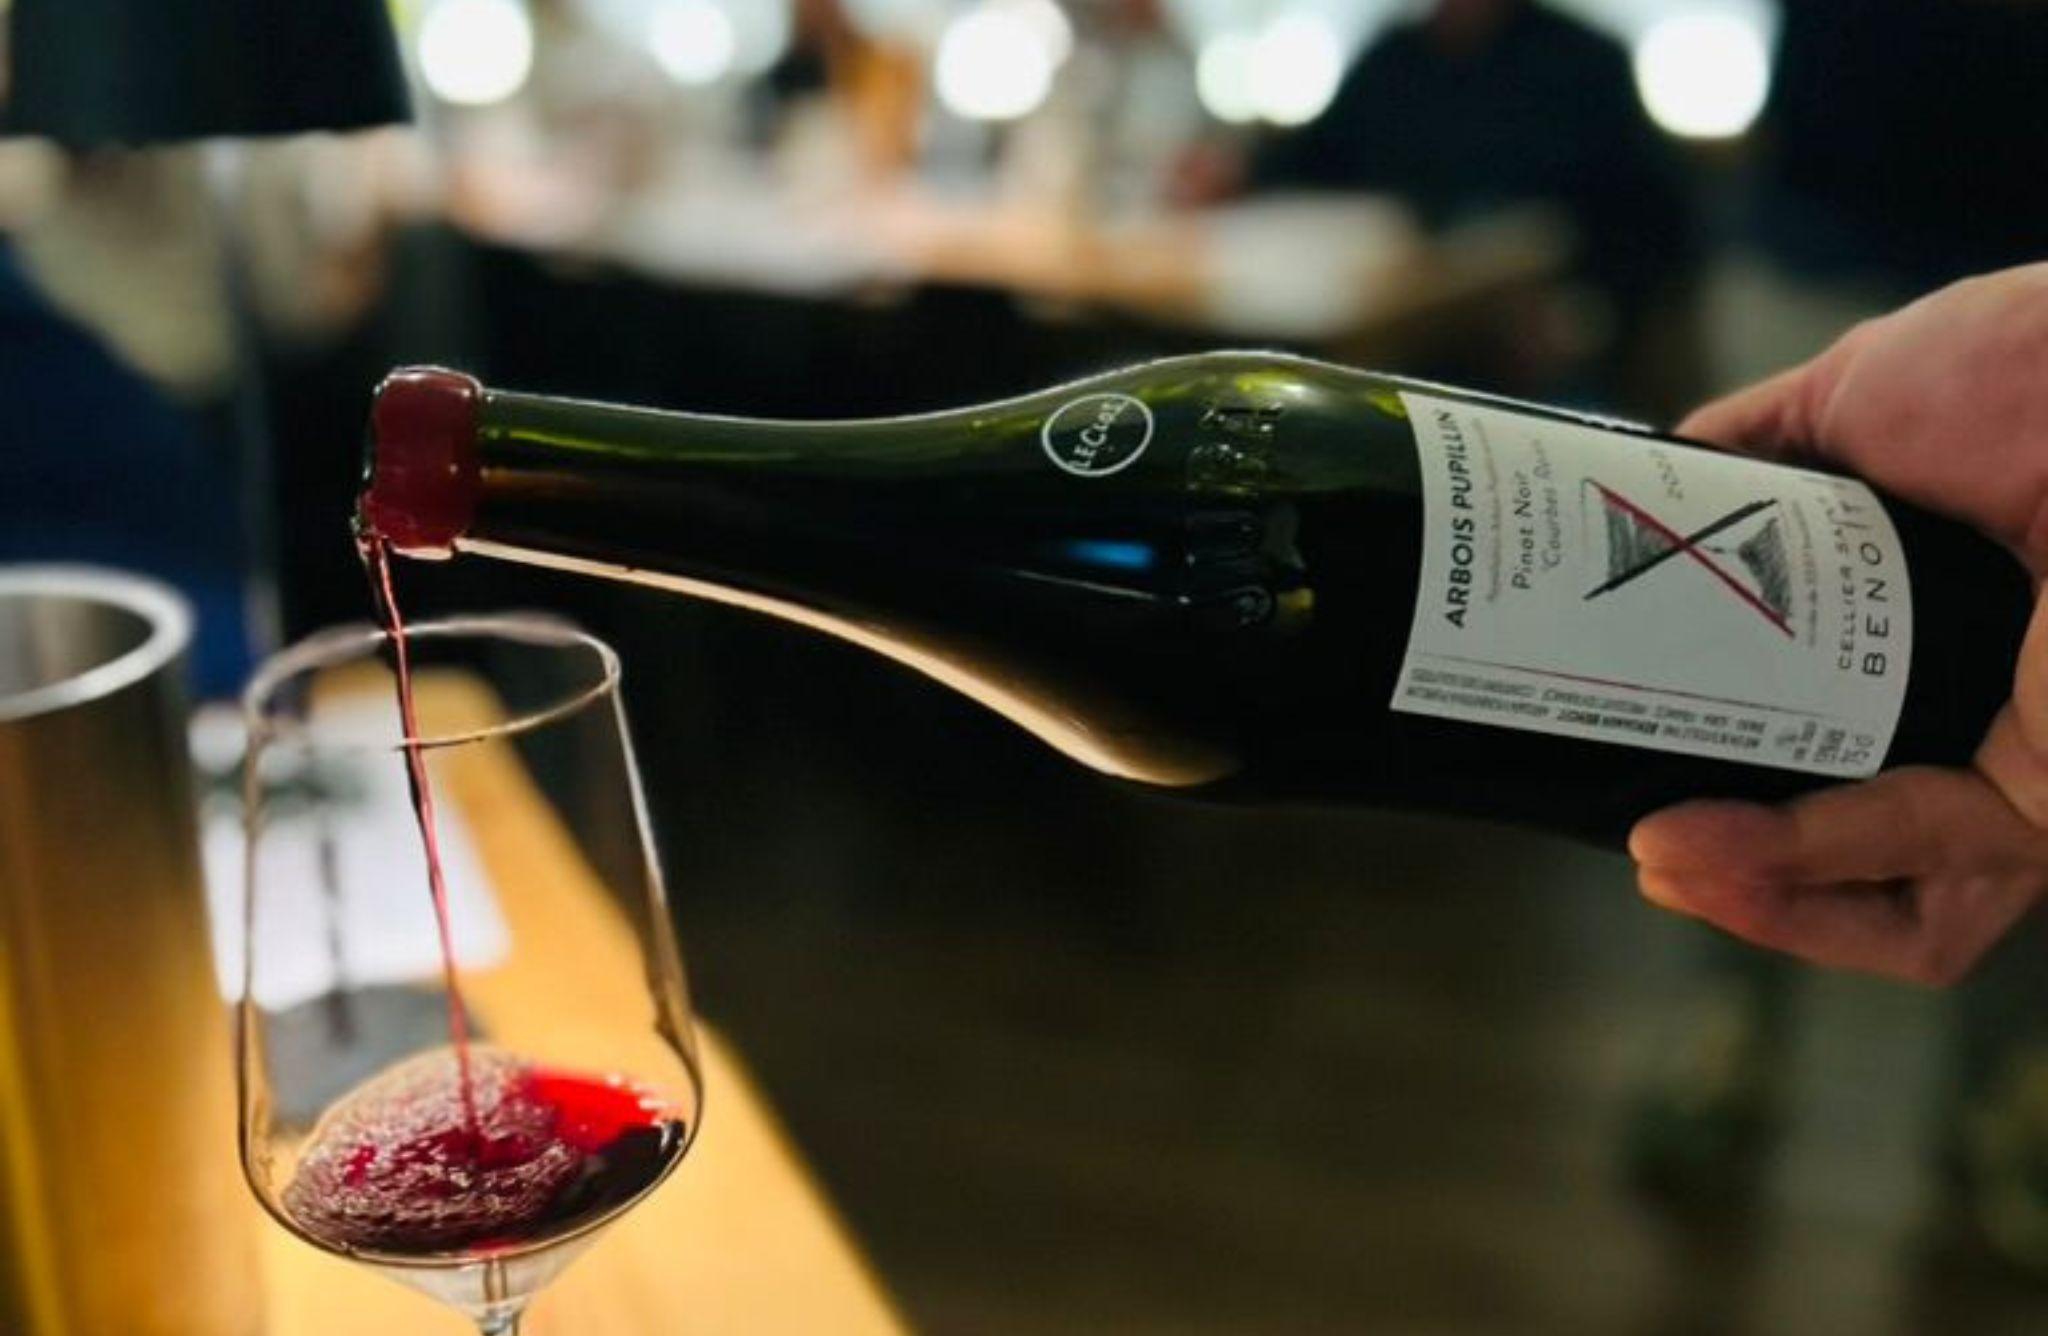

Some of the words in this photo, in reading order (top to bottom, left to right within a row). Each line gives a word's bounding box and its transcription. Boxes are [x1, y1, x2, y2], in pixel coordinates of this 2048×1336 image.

[1438, 410, 1473, 510] PUPILLIN
[1511, 469, 1533, 518] Noir
[1445, 517, 1475, 629] ARBOIS
[1511, 526, 1535, 590] Pinot
[1838, 565, 1857, 670] CELLIER
